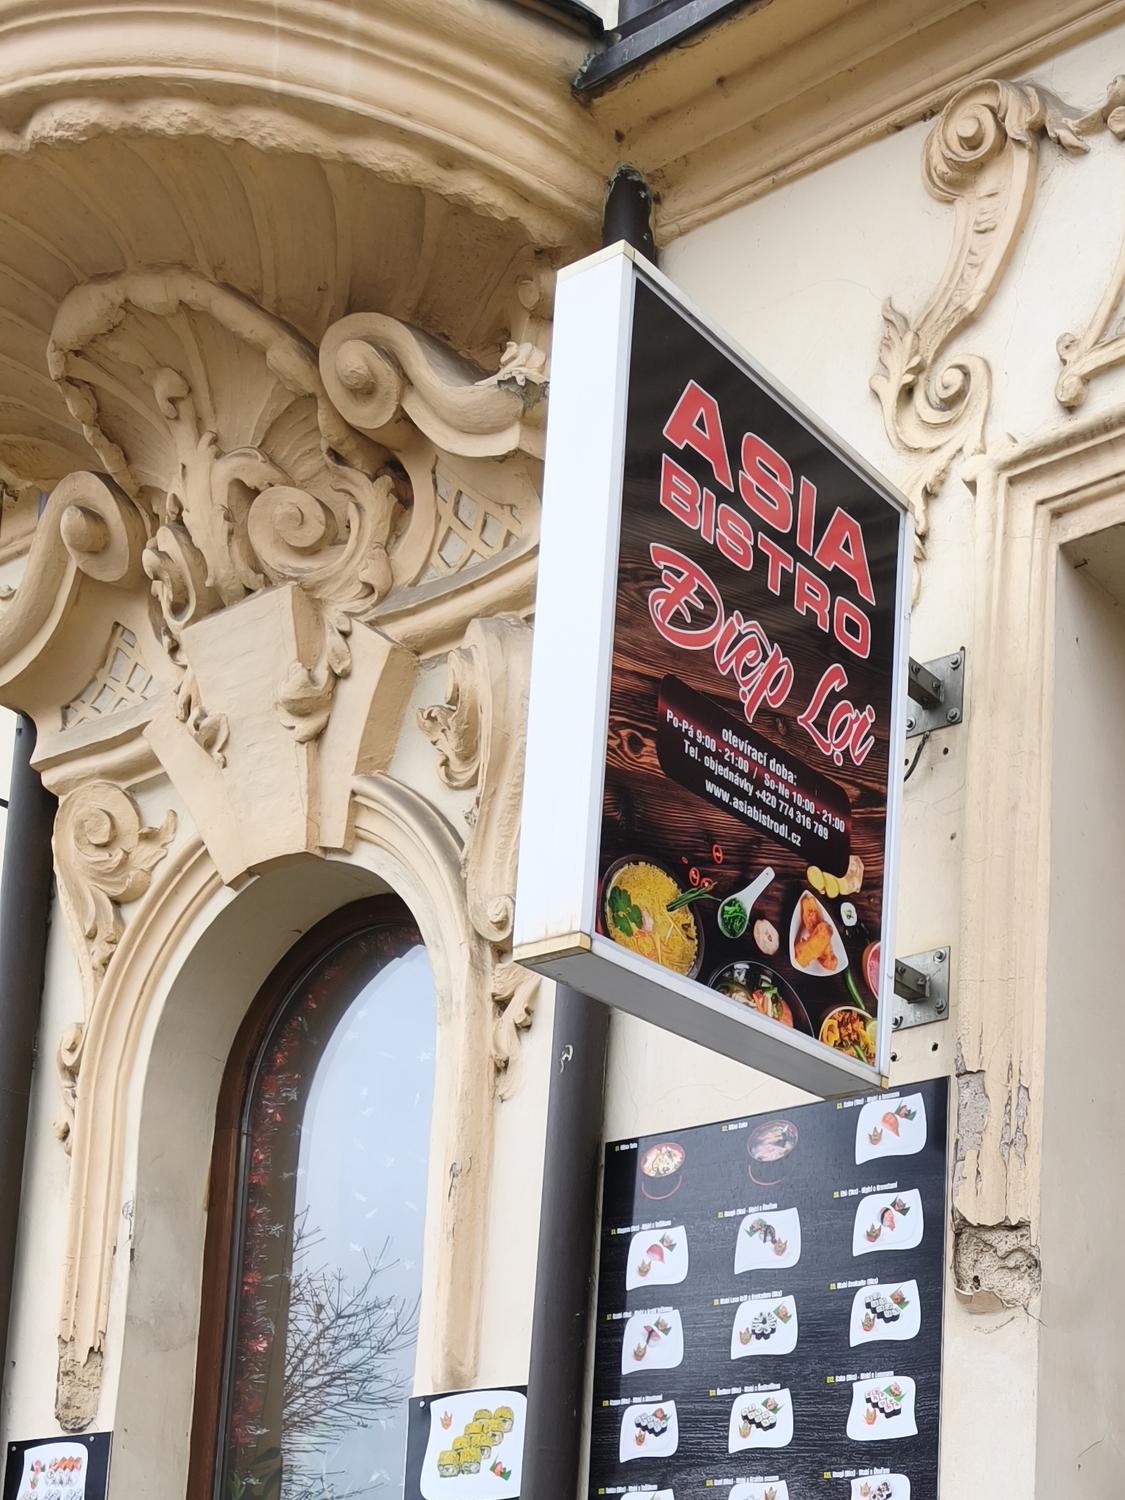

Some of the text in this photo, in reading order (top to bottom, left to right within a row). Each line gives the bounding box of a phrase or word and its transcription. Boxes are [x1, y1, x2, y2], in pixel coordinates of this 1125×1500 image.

[663, 379, 875, 606] ASIA
[660, 453, 871, 659] BISTRO
[667, 709, 693, 738] Po-Pá
[696, 730, 716, 752] 9:00
[724, 748, 749, 773] 21:00
[753, 767, 758, 779] /
[764, 773, 789, 798] So-Ne
[792, 792, 815, 814] 10:00
[822, 810, 845, 832] 21:00
[684, 739, 828, 840] Tel. objednávky +420 774 316 789
[722, 728, 797, 786] otevírací doba:
[706, 780, 801, 847] www.asiabistrodl.cz
